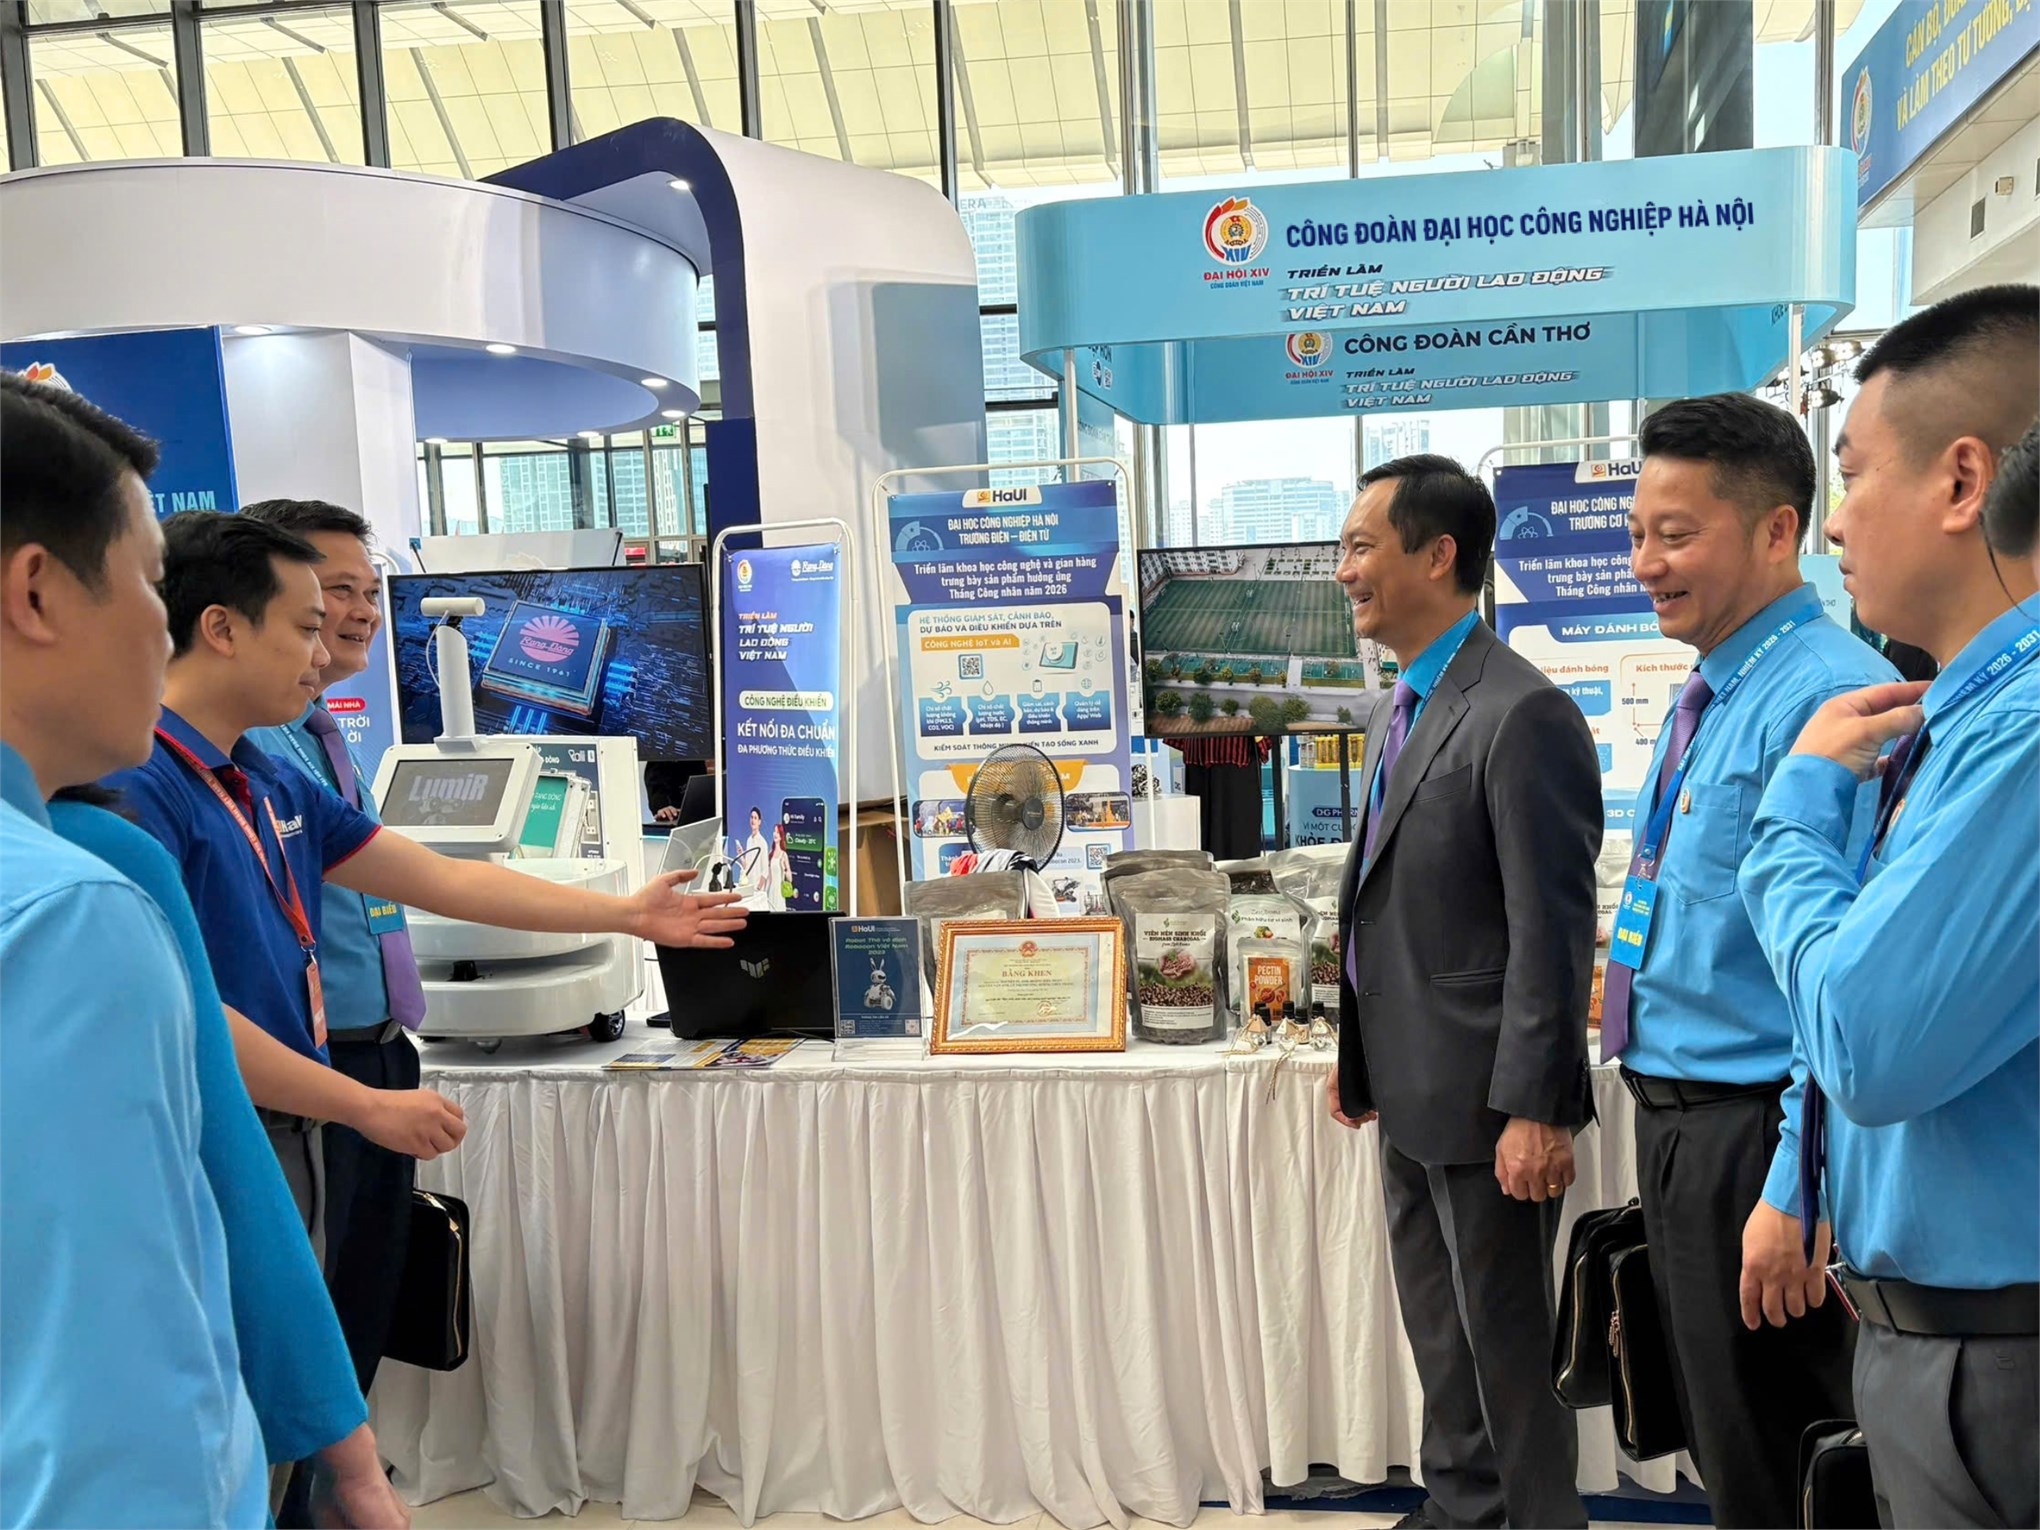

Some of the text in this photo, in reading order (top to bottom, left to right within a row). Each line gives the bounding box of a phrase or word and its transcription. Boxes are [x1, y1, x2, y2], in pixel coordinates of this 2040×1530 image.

[1906, 20, 1925, 68] CÁN
[1897, 43, 1955, 131] VÀ LÀM THEO
[1286, 197, 1754, 247] CÔNG ĐOÀN ĐẠI HỌC CÔNG NGHIỆP HÀ NỘI
[1204, 268, 1270, 281] ĐẠI HỘI XIV
[1286, 263, 1383, 279] TRIỂN LÃM
[1287, 266, 1604, 301] TRÍ TUỆ NGƯỜI LAO ĐỘNG
[1287, 300, 1406, 321] VIỆT NAM
[1344, 321, 1591, 355] CÔNG ĐOÀN CẦN THƠ
[1302, 370, 1317, 378] HỘI
[1346, 367, 1415, 379] TRIỂN LÃM
[1345, 371, 1573, 394] TRÍ TUỆ NGƯỜI LAO ĐỘNG
[1345, 394, 1432, 408] VIỆT NAM
[172, 490, 216, 513] NAM
[992, 488, 1028, 502] HaUI
[1551, 496, 1617, 515] ĐẠI HỌC CÔNG
[948, 512, 1059, 531] ĐẠI HỌC CÔNG NGHIỆP HÀ NỘI
[1569, 513, 1623, 531] TRƯỜNG CƠ
[959, 531, 990, 545] TRƯỜNG
[914, 556, 1097, 575] Triển lãm khoa học công nghệ và gian hàng
[1518, 556, 1608, 571] Triển lãm khoa học
[941, 571, 1054, 588] trưng bày sản phẩm hưởng
[1548, 569, 1612, 584] trưng bày sản
[949, 584, 1068, 600] Tháng Công nhân năm 2026
[1556, 582, 1637, 597] Tháng Công nhân
[932, 614, 962, 624] THỐNG
[965, 612, 986, 622] GIÁM
[738, 622, 814, 634] TRÍ TUỆ NGƯỜI
[935, 623, 953, 633] BÁO
[991, 620, 1017, 630] KHIỂN
[1039, 619, 1062, 628] TRÊN
[1562, 621, 1637, 636] MÁY ĐÁNH
[739, 636, 789, 648] LAO ĐỘNG
[924, 640, 948, 649] CÔNG
[975, 639, 989, 647] IoT
[1002, 638, 1012, 646] AI
[739, 650, 787, 661] VIỆT NAM
[1986, 653, 2012, 676] 2026
[2015, 630, 2040, 653] 2031
[508, 657, 570, 677] SINCE 1961
[1560, 664, 1609, 674] đánh bóng
[1635, 661, 1688, 672] Kích thước
[744, 692, 827, 709] CÔNG NGHỆ ĐIỀU KHIỂN
[337, 714, 370, 729] TRỜI
[737, 717, 835, 740] KẾT NỐI ĐA CHUẨN
[737, 744, 748, 754] ĐA
[749, 744, 777, 756] PHƯƠNG
[778, 743, 797, 756] THỨC
[797, 744, 815, 757] ĐIỀU
[1257, 965, 1281, 975] PECTIN
[1254, 975, 1283, 985] POWDER
